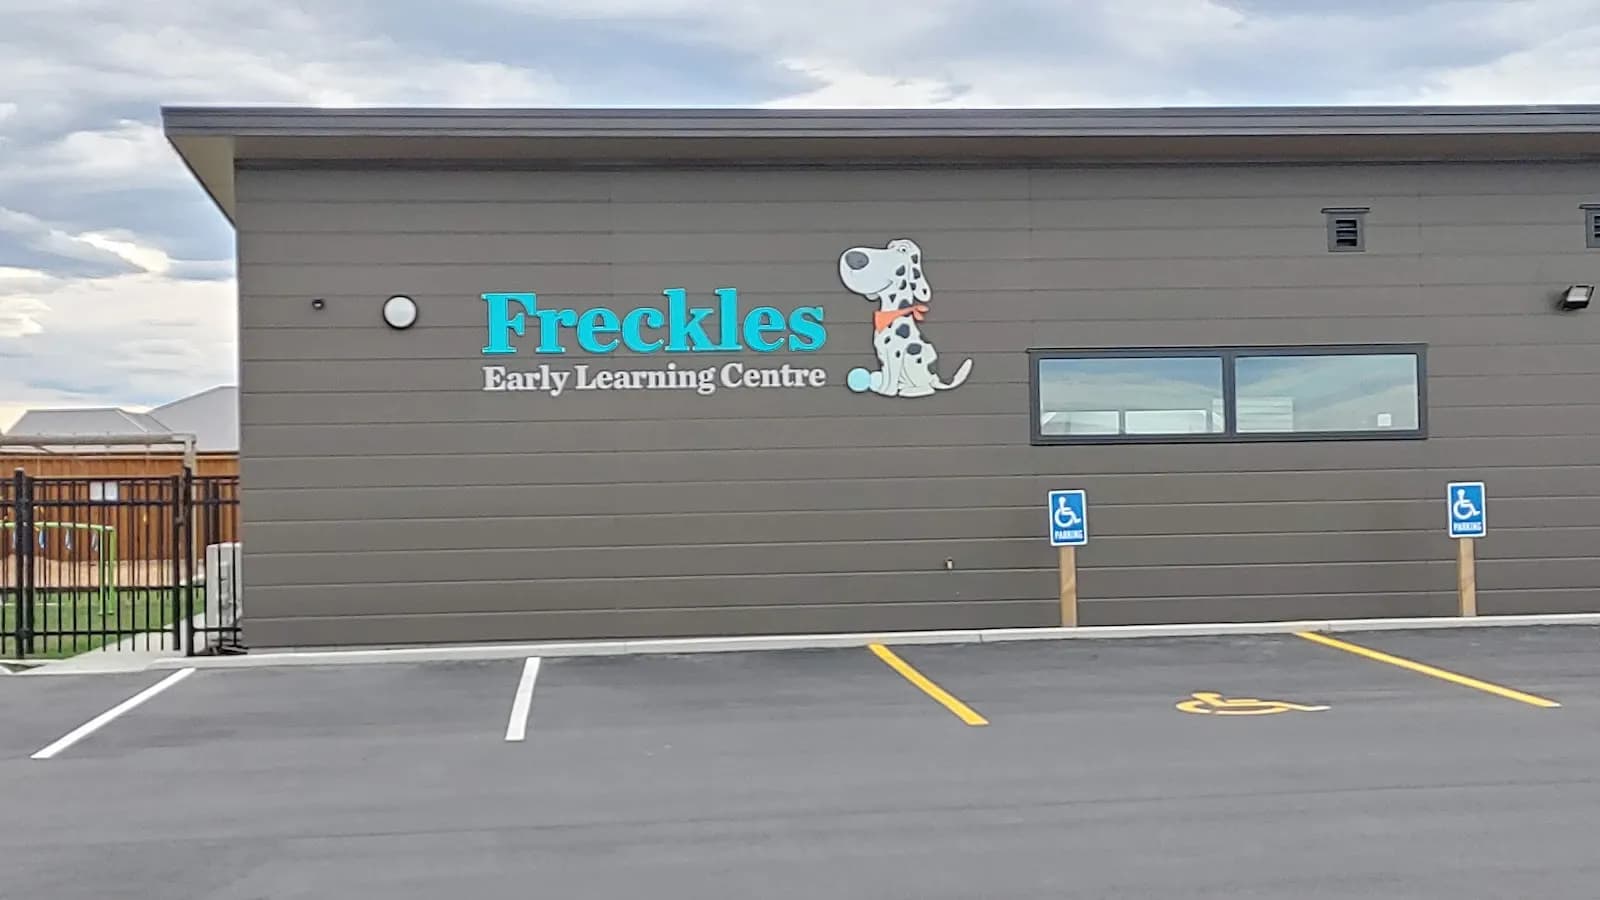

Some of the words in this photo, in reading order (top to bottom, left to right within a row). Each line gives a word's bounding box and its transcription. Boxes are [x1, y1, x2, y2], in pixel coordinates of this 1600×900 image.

[481, 287, 828, 355] Freckles
[482, 364, 571, 397] Early
[574, 363, 717, 395] Learning
[720, 362, 826, 389] Centre
